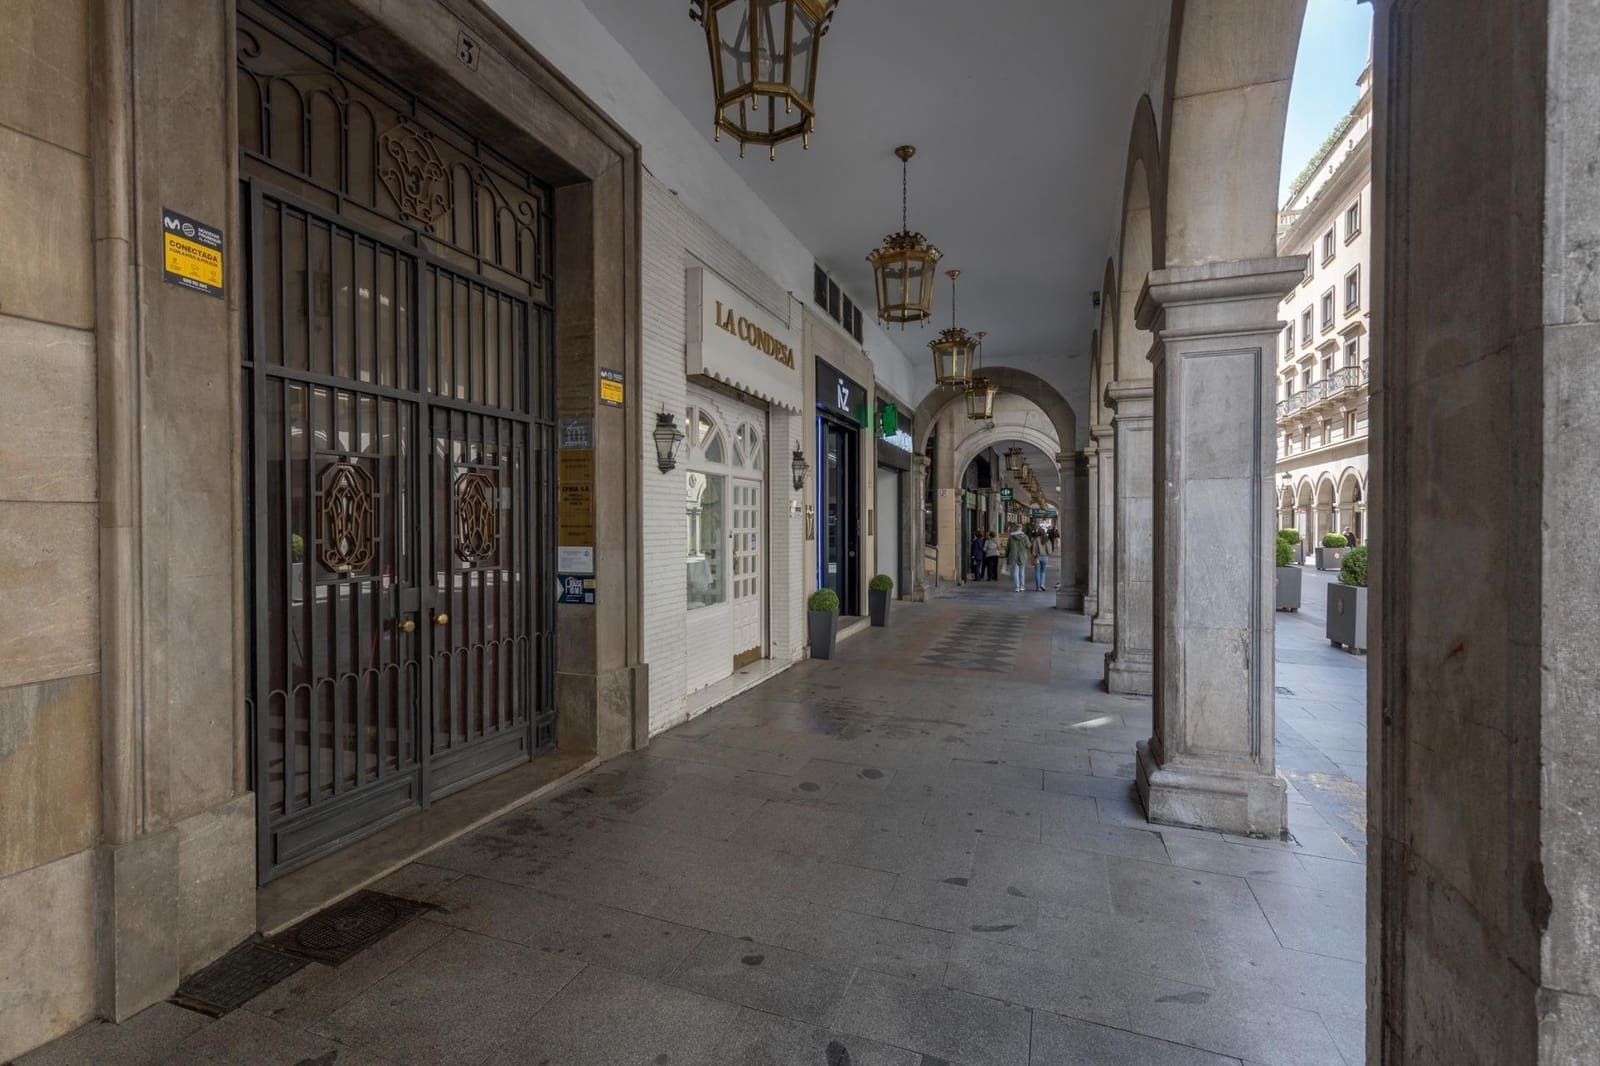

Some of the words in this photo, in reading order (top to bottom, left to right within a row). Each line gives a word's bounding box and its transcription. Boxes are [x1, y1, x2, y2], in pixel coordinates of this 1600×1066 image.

[460, 38, 473, 65] 3
[169, 239, 218, 263] CONECTADA
[715, 300, 737, 336] LA
[737, 316, 795, 370] CONDESA
